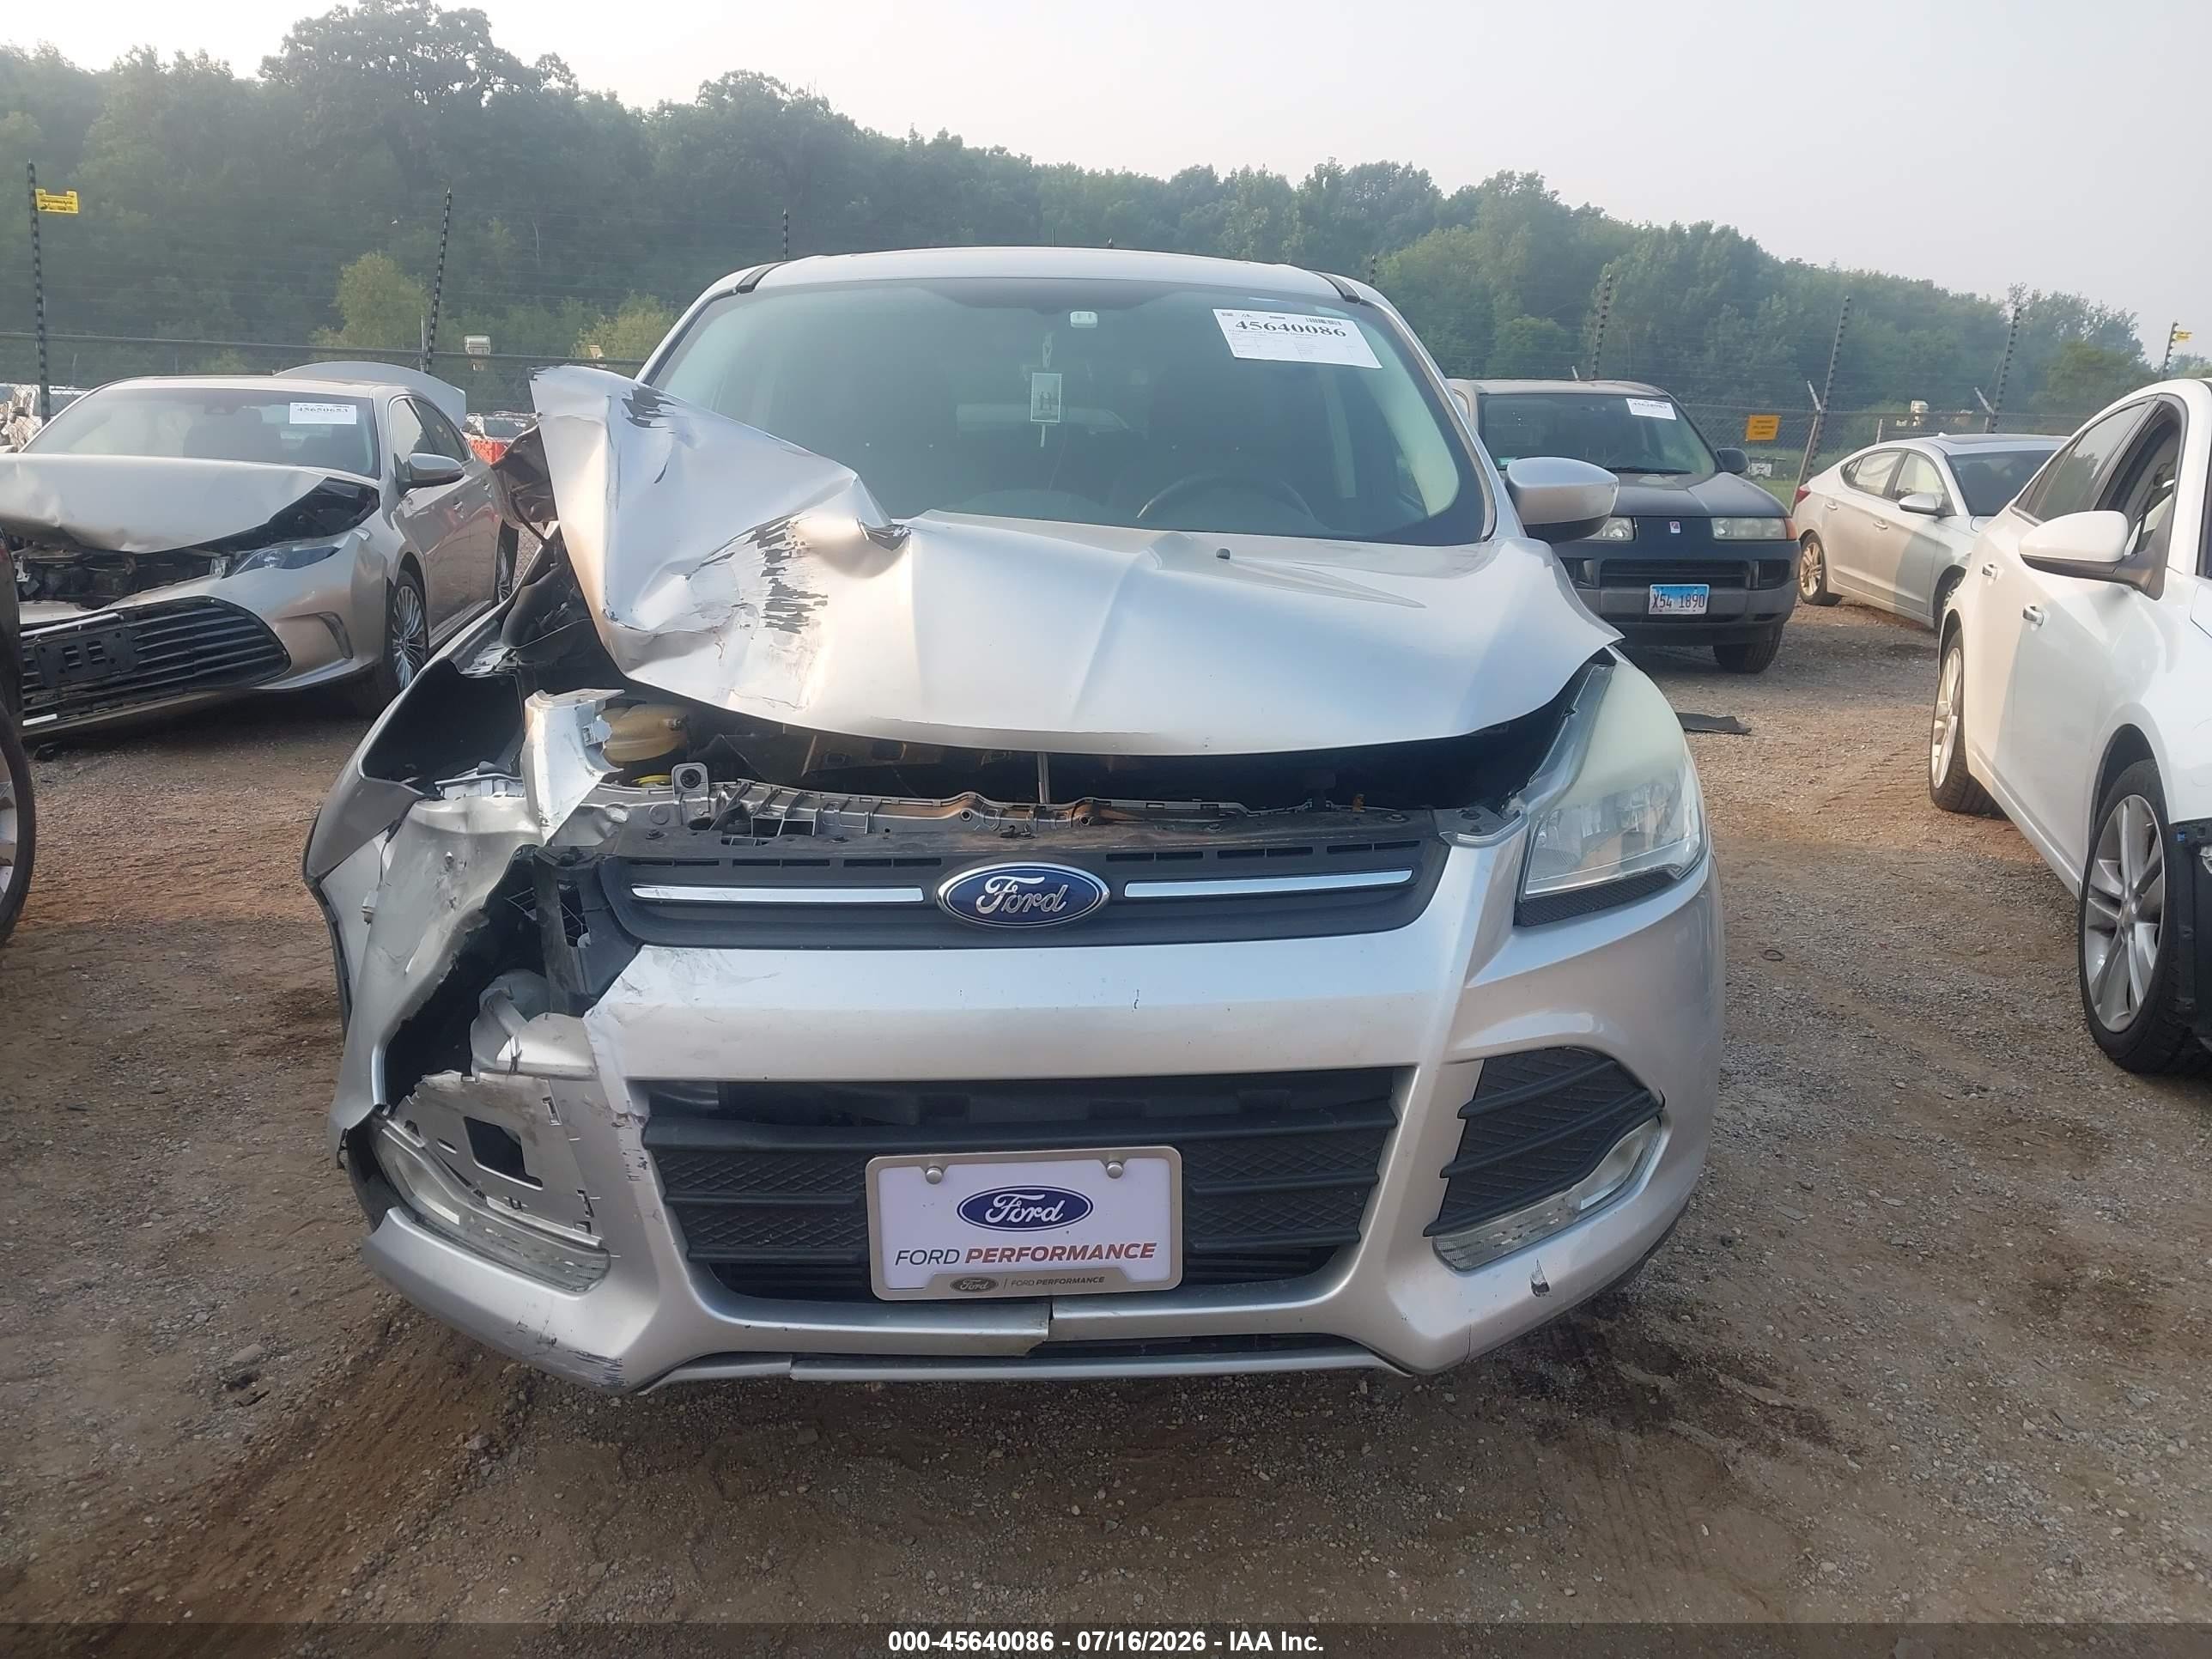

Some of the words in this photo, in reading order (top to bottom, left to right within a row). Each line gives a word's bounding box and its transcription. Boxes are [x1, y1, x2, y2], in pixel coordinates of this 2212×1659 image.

[1235, 319, 1346, 337] 45640086
[1652, 593, 1673, 609] X54
[1679, 593, 1705, 609] 1890
[975, 875, 1069, 914] Ford
[984, 1193, 1066, 1224] Ford
[895, 1249, 960, 1266] FORD
[965, 1243, 1157, 1264] PERFORMANCE
[960, 1278, 989, 1291] Ford
[1036, 1276, 1105, 1286] PERFORMANCE
